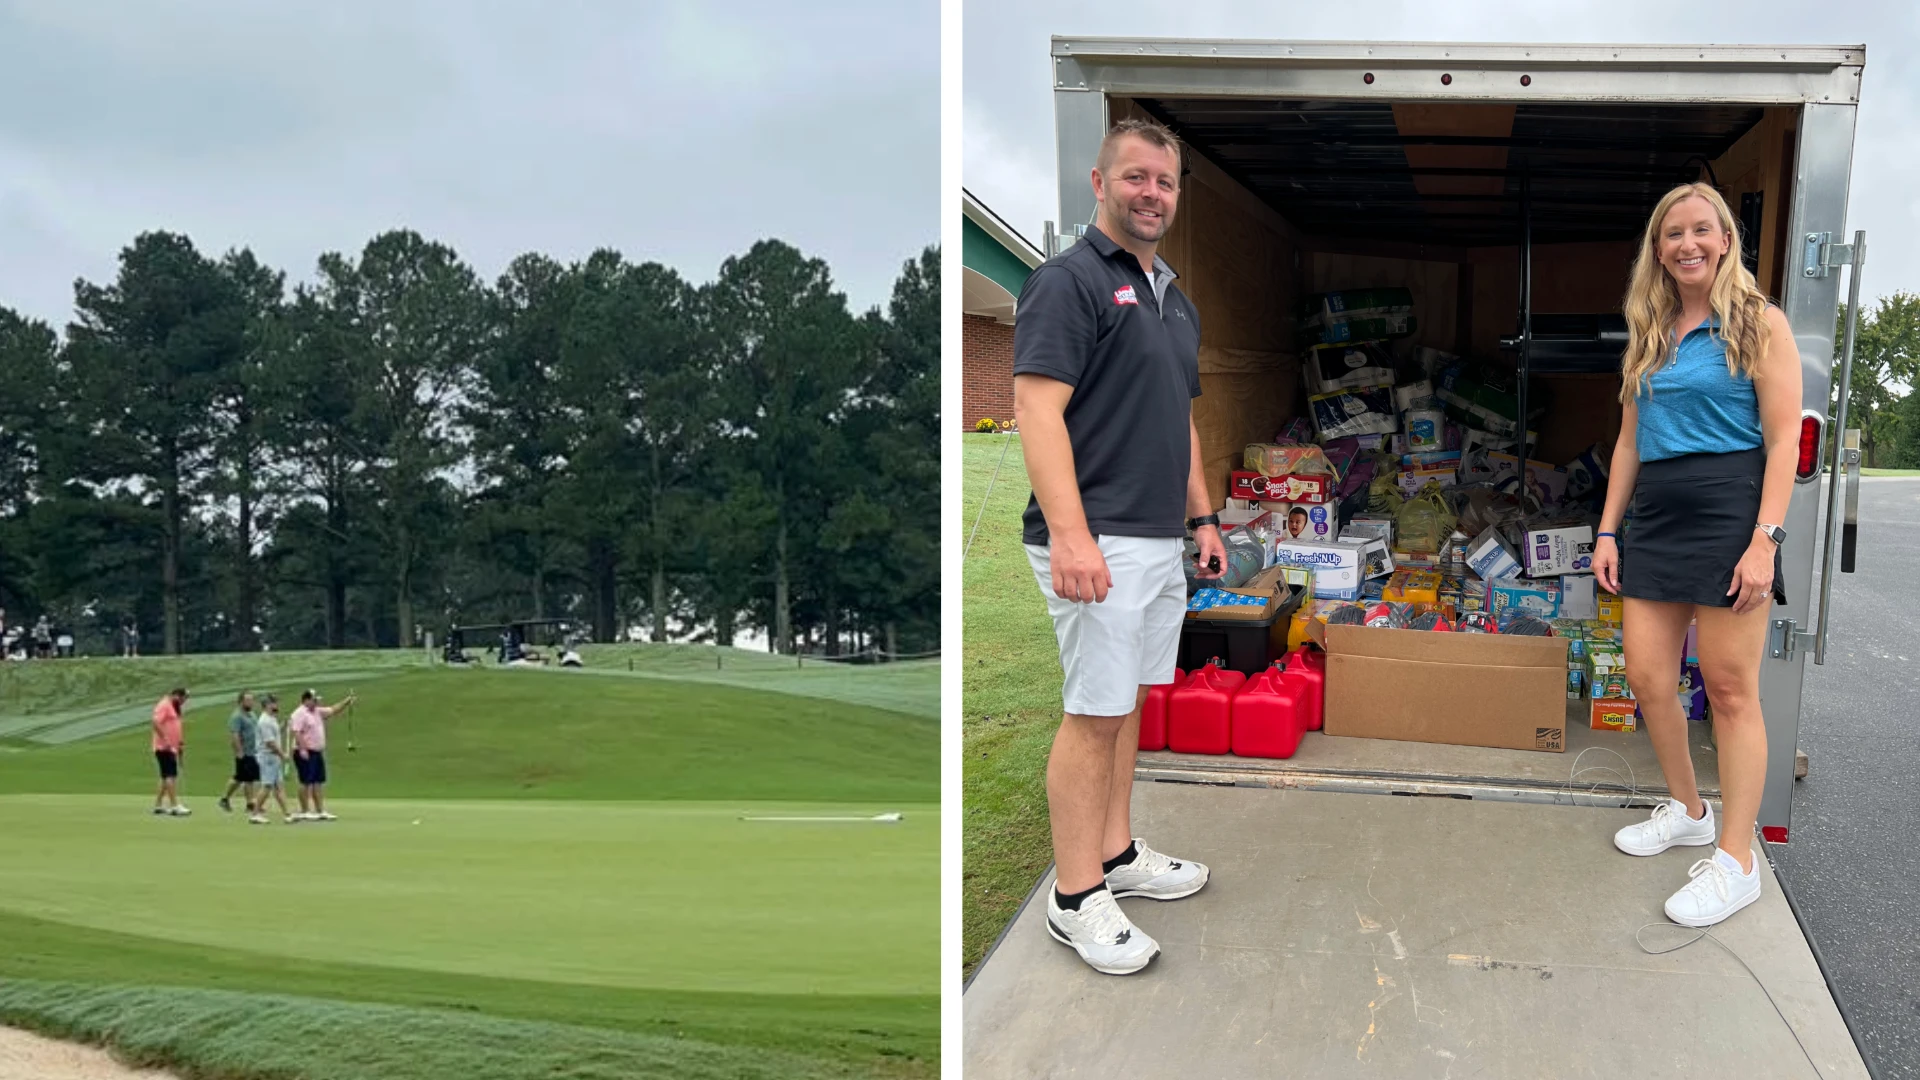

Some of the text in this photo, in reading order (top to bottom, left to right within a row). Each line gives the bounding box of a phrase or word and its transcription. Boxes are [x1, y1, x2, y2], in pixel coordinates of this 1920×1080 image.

[1266, 481, 1288, 490] Snack
[1328, 553, 1342, 566] Up
[1603, 715, 1624, 723] BUSH'S
